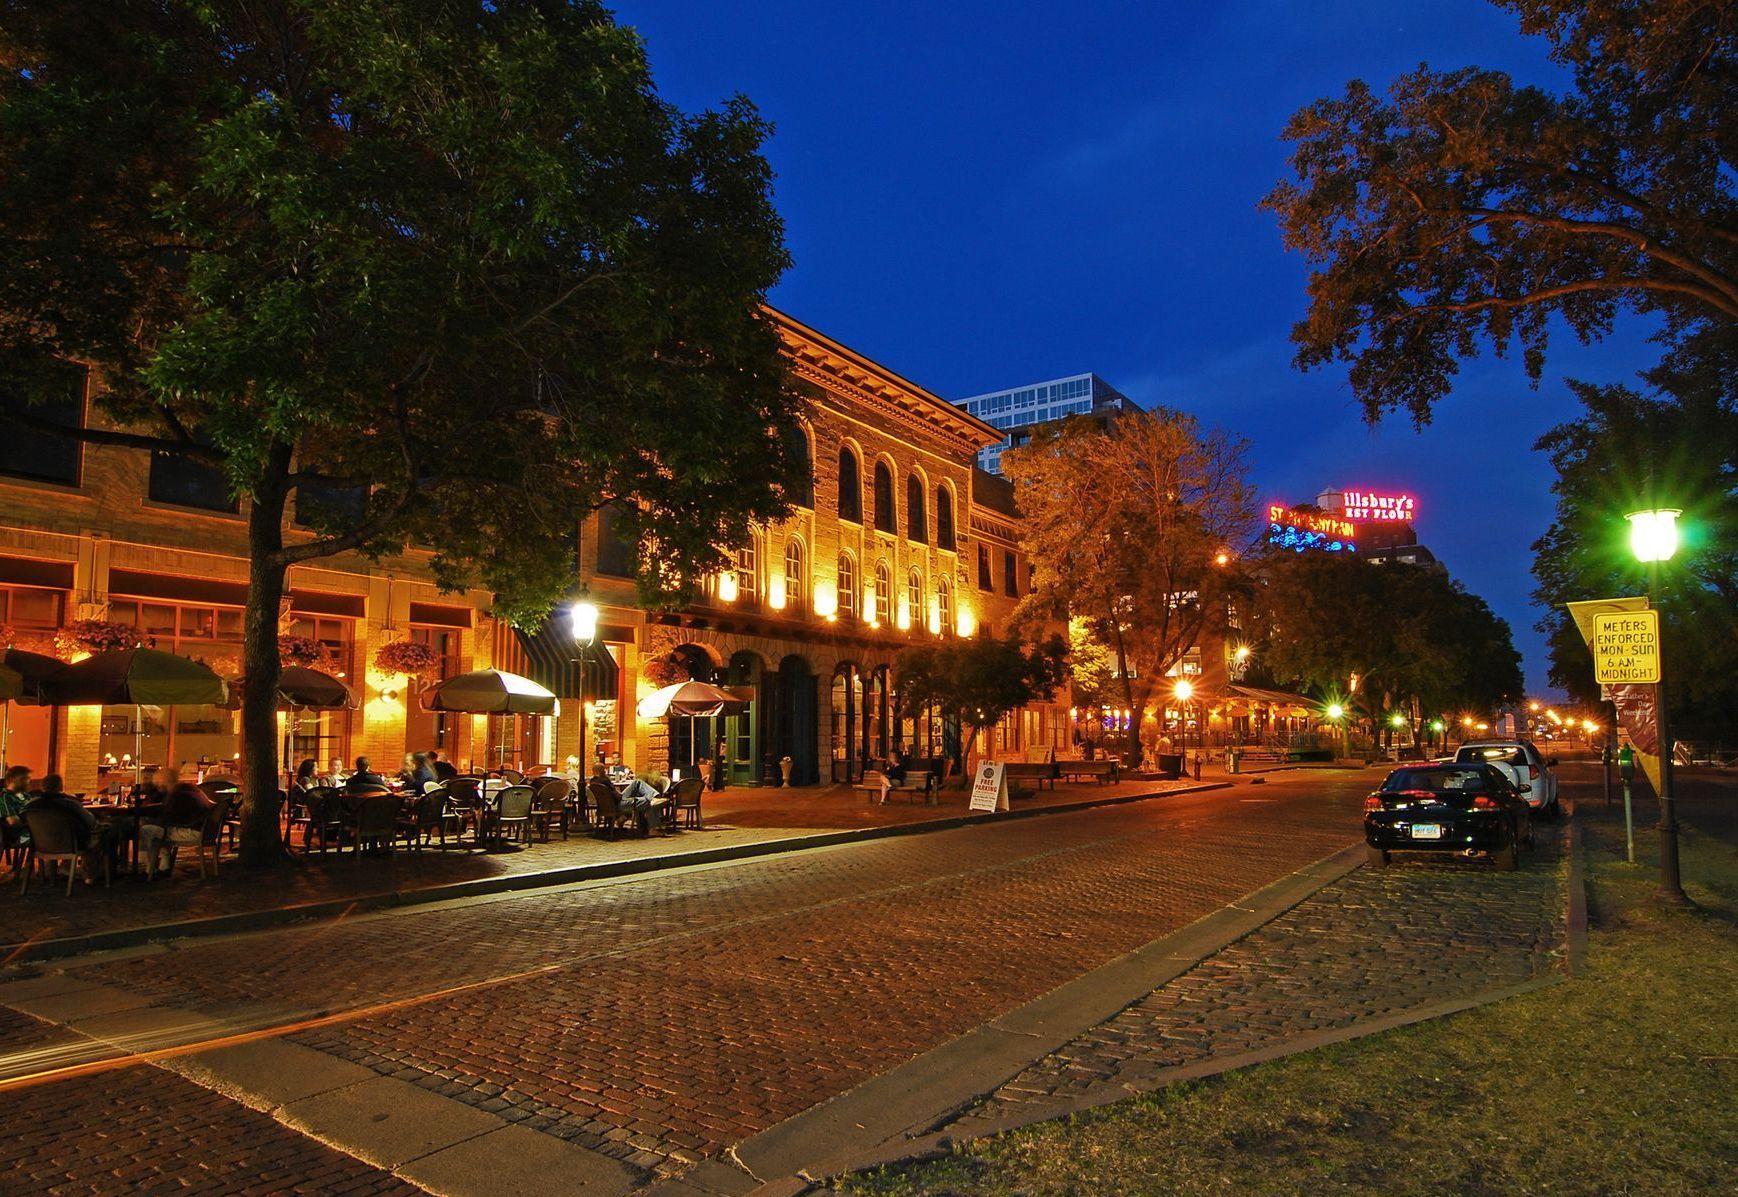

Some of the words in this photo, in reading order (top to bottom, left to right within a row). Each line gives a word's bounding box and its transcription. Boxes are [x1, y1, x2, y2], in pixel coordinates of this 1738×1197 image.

[1373, 509, 1412, 519] FLOUR
[1603, 620, 1647, 632] METERS
[1598, 633, 1654, 644] ENFORCED
[1607, 658, 1614, 668] 6
[1601, 669, 1653, 679] MIDNIGHT
[975, 784, 998, 793] PARKING
